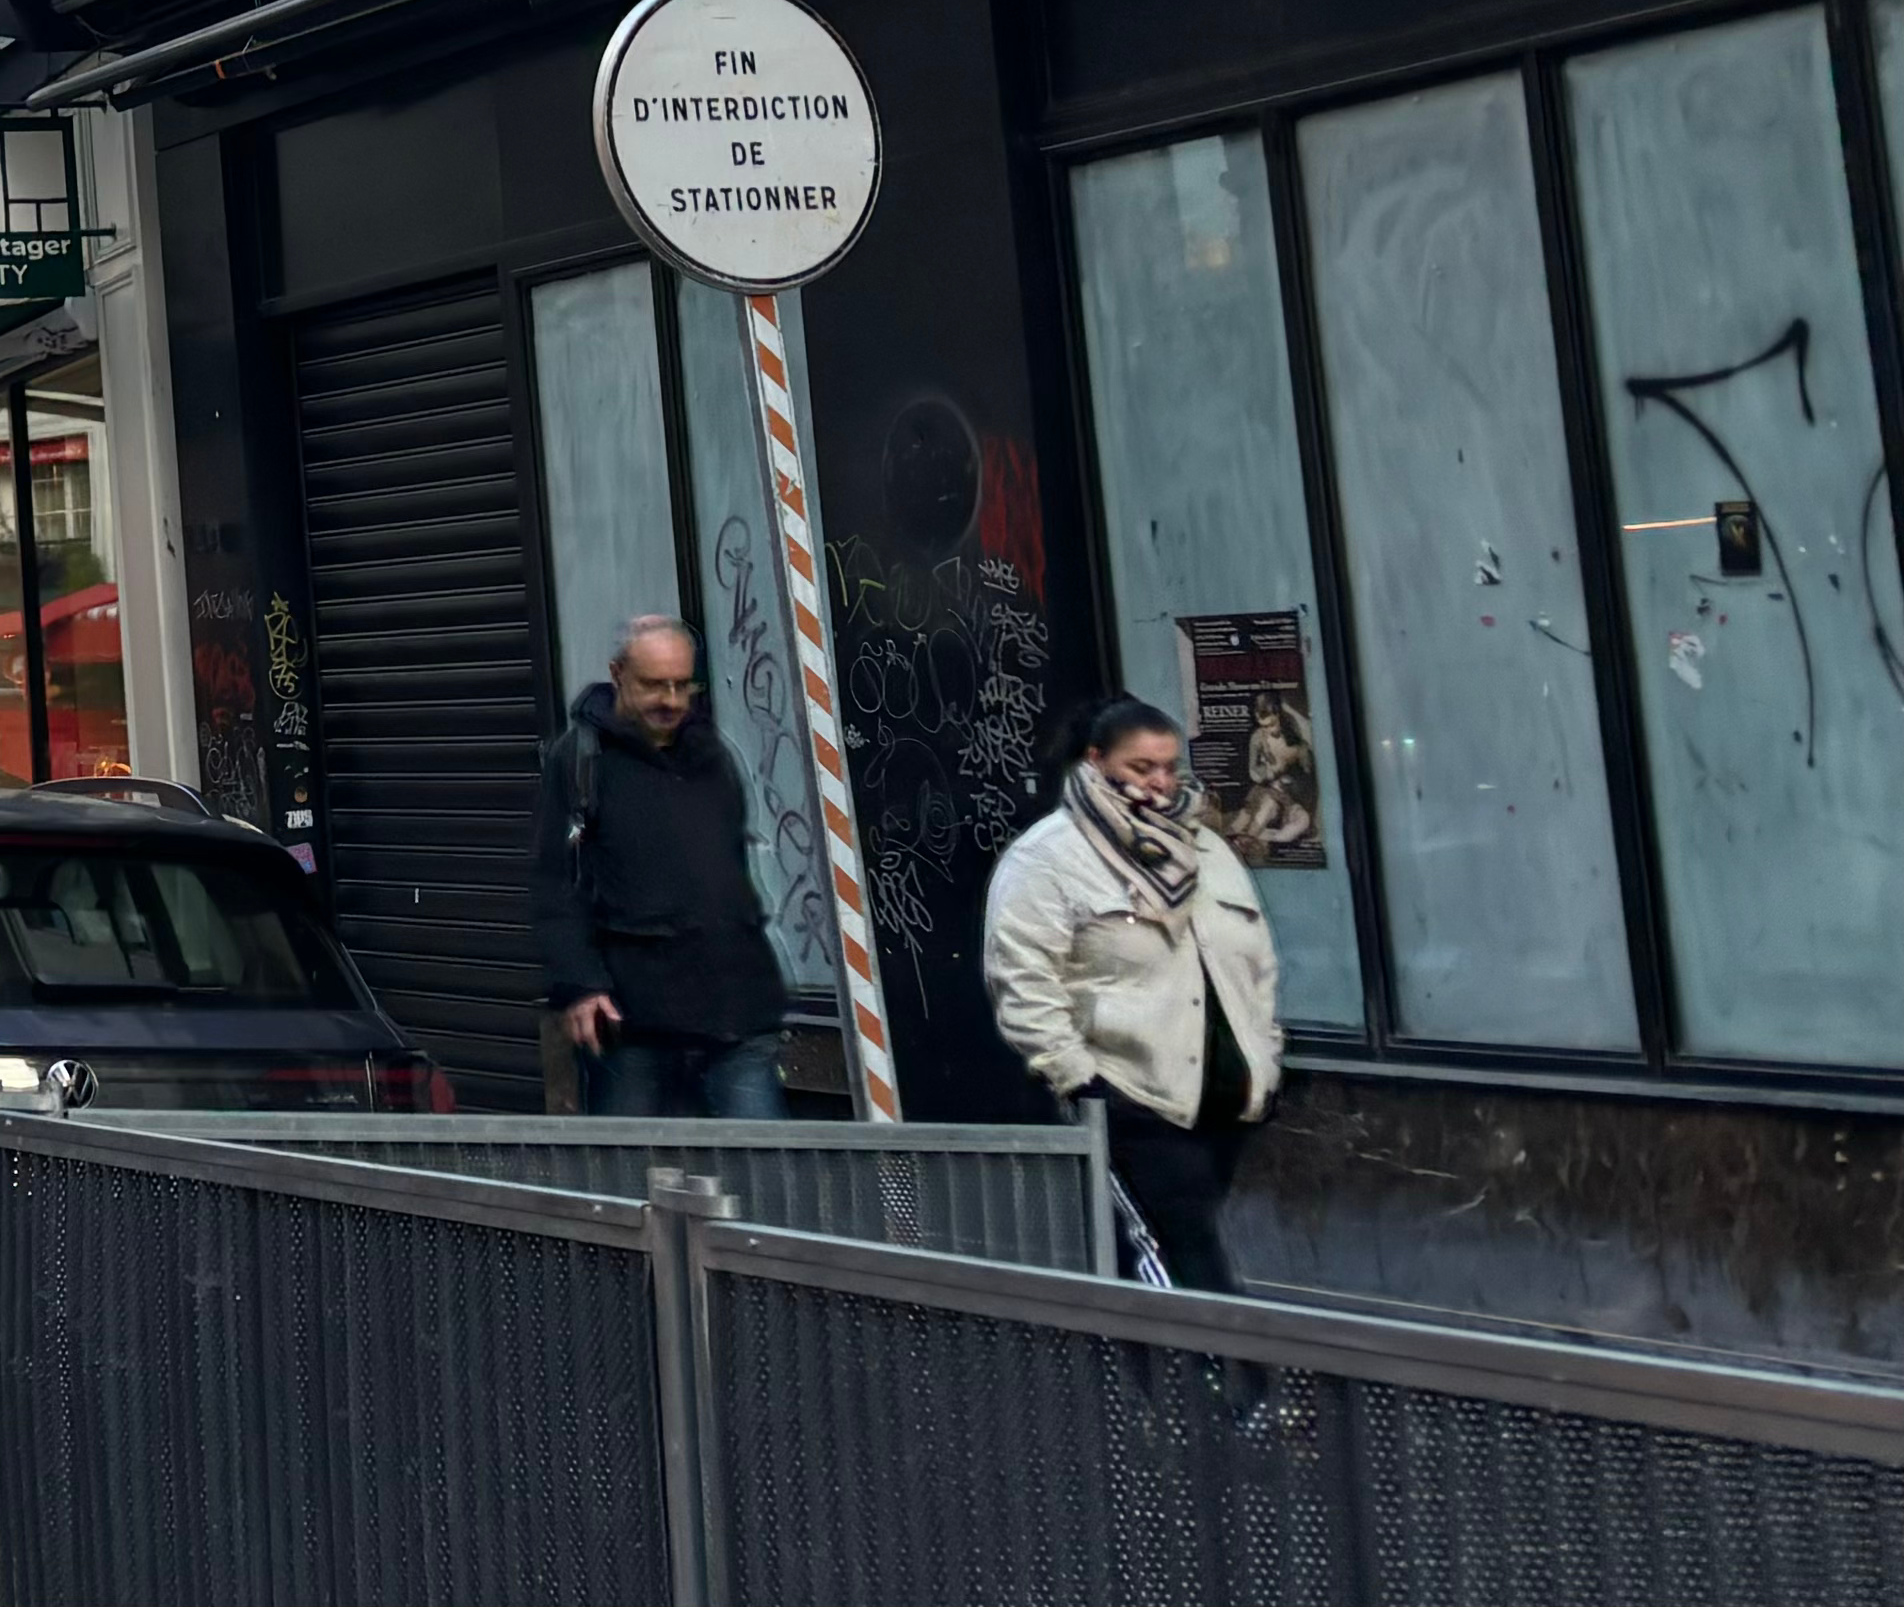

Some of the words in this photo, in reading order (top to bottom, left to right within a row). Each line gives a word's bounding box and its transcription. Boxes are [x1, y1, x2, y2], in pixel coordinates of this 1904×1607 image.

[715, 51, 757, 75] FIN
[634, 95, 849, 122] D'INTERDICTION
[731, 142, 765, 166] DE
[671, 186, 836, 213] STATIONNER
